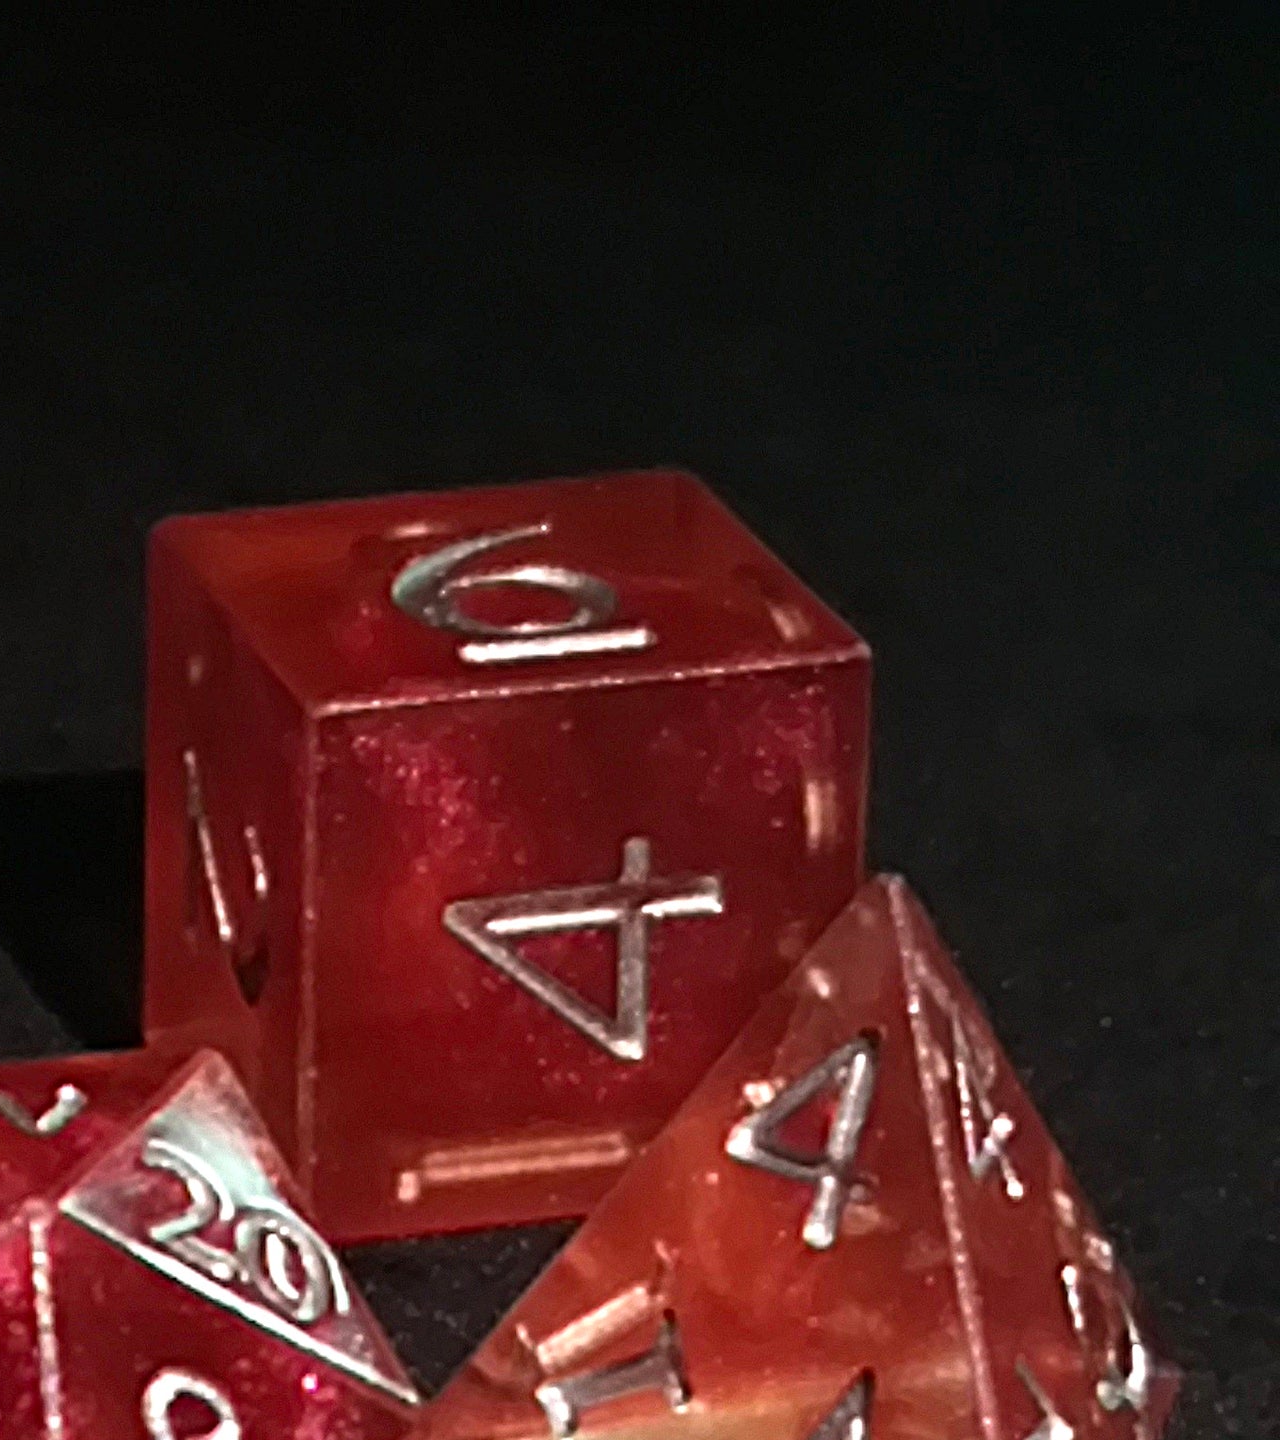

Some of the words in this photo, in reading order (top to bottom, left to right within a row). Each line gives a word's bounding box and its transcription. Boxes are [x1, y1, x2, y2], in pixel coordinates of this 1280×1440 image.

[390, 521, 658, 664] 6
[443, 836, 724, 1061] 4
[140, 1137, 352, 1325] 20
[725, 1027, 882, 1250] 4
